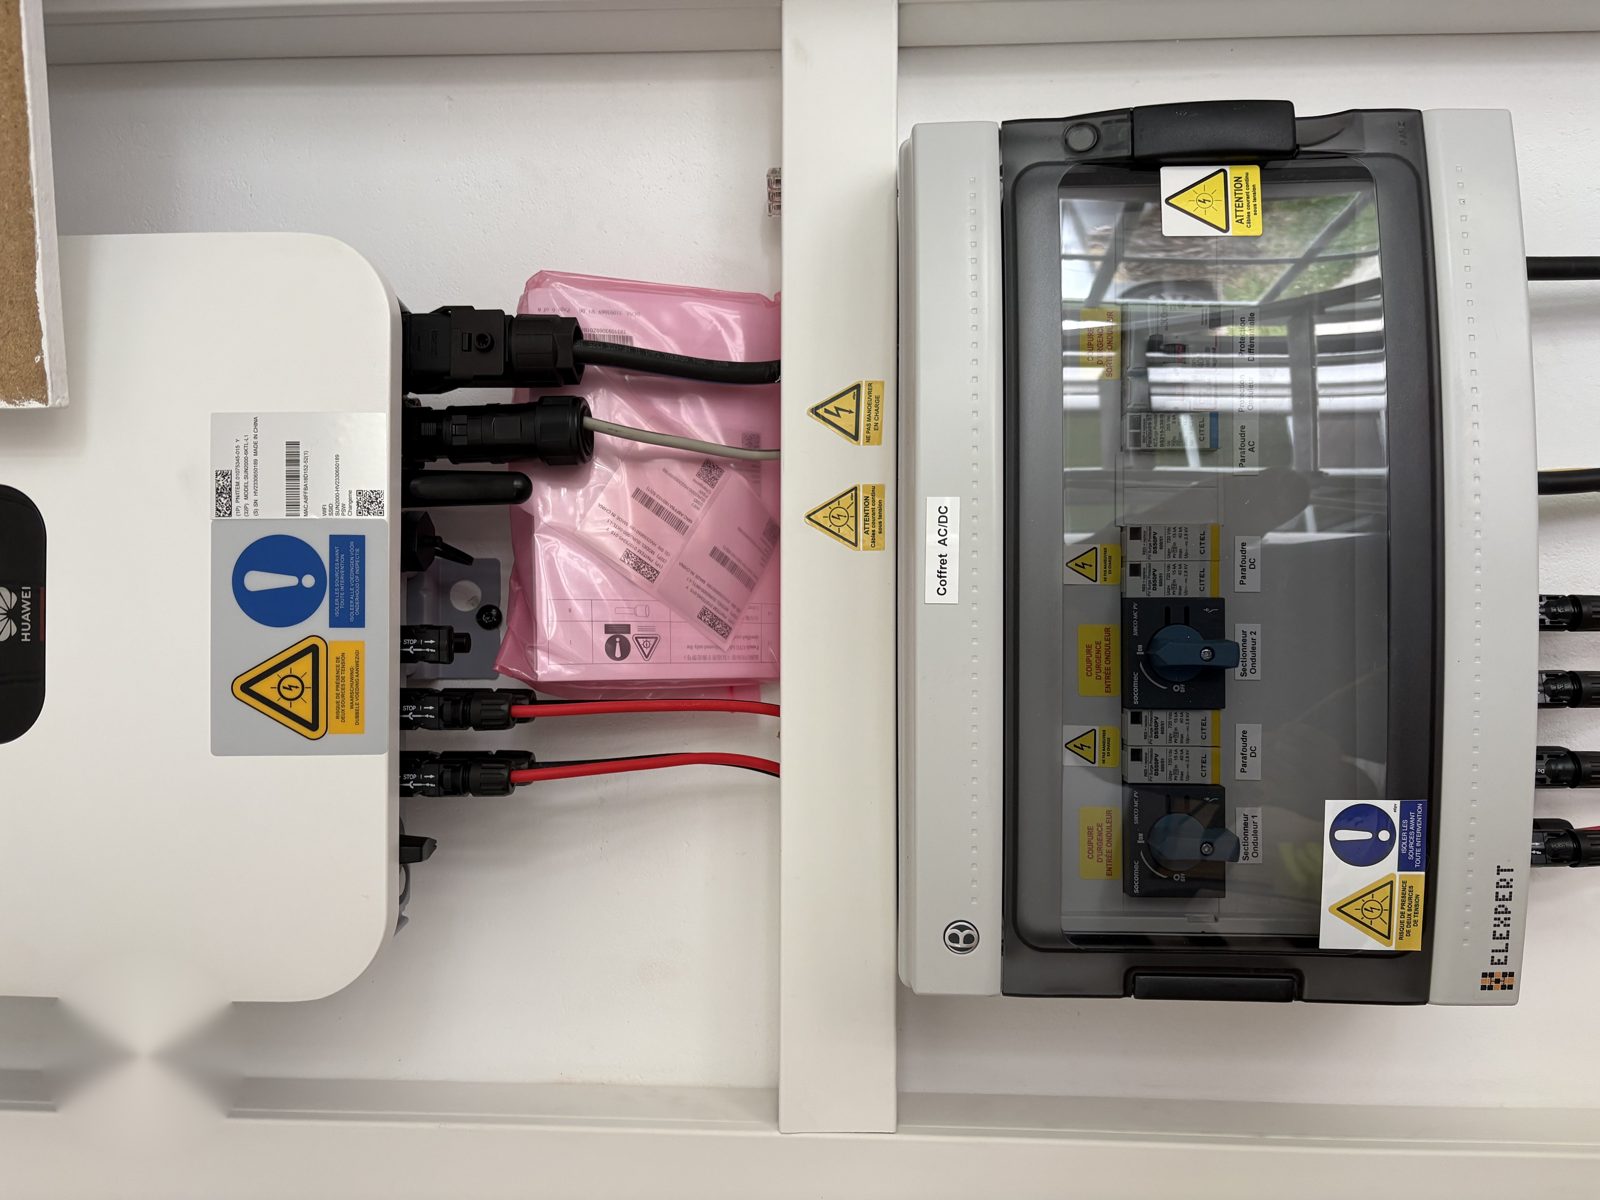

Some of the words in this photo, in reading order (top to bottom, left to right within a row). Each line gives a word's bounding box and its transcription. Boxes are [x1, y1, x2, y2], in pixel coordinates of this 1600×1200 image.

[1233, 176, 1244, 225] ATTENTION
[1247, 312, 1255, 362] Dfférentielle
[866, 435, 871, 443] NE
[874, 422, 879, 431] EN
[1238, 425, 1246, 468] Parafoudre
[1248, 441, 1255, 453] AC
[938, 506, 948, 547] AC/DC
[936, 554, 947, 596] Coffret
[1239, 542, 1247, 585] Parafoudre
[1249, 558, 1256, 570] DC
[21, 586, 31, 642] HUAWEI
[335, 656, 340, 664] DE
[1240, 730, 1248, 774] Parafoudre
[1250, 746, 1257, 758] DC
[1415, 803, 1423, 847] INTERVENTION
[1413, 919, 1419, 927] DE
[1490, 865, 1514, 966] ELEXPERT
